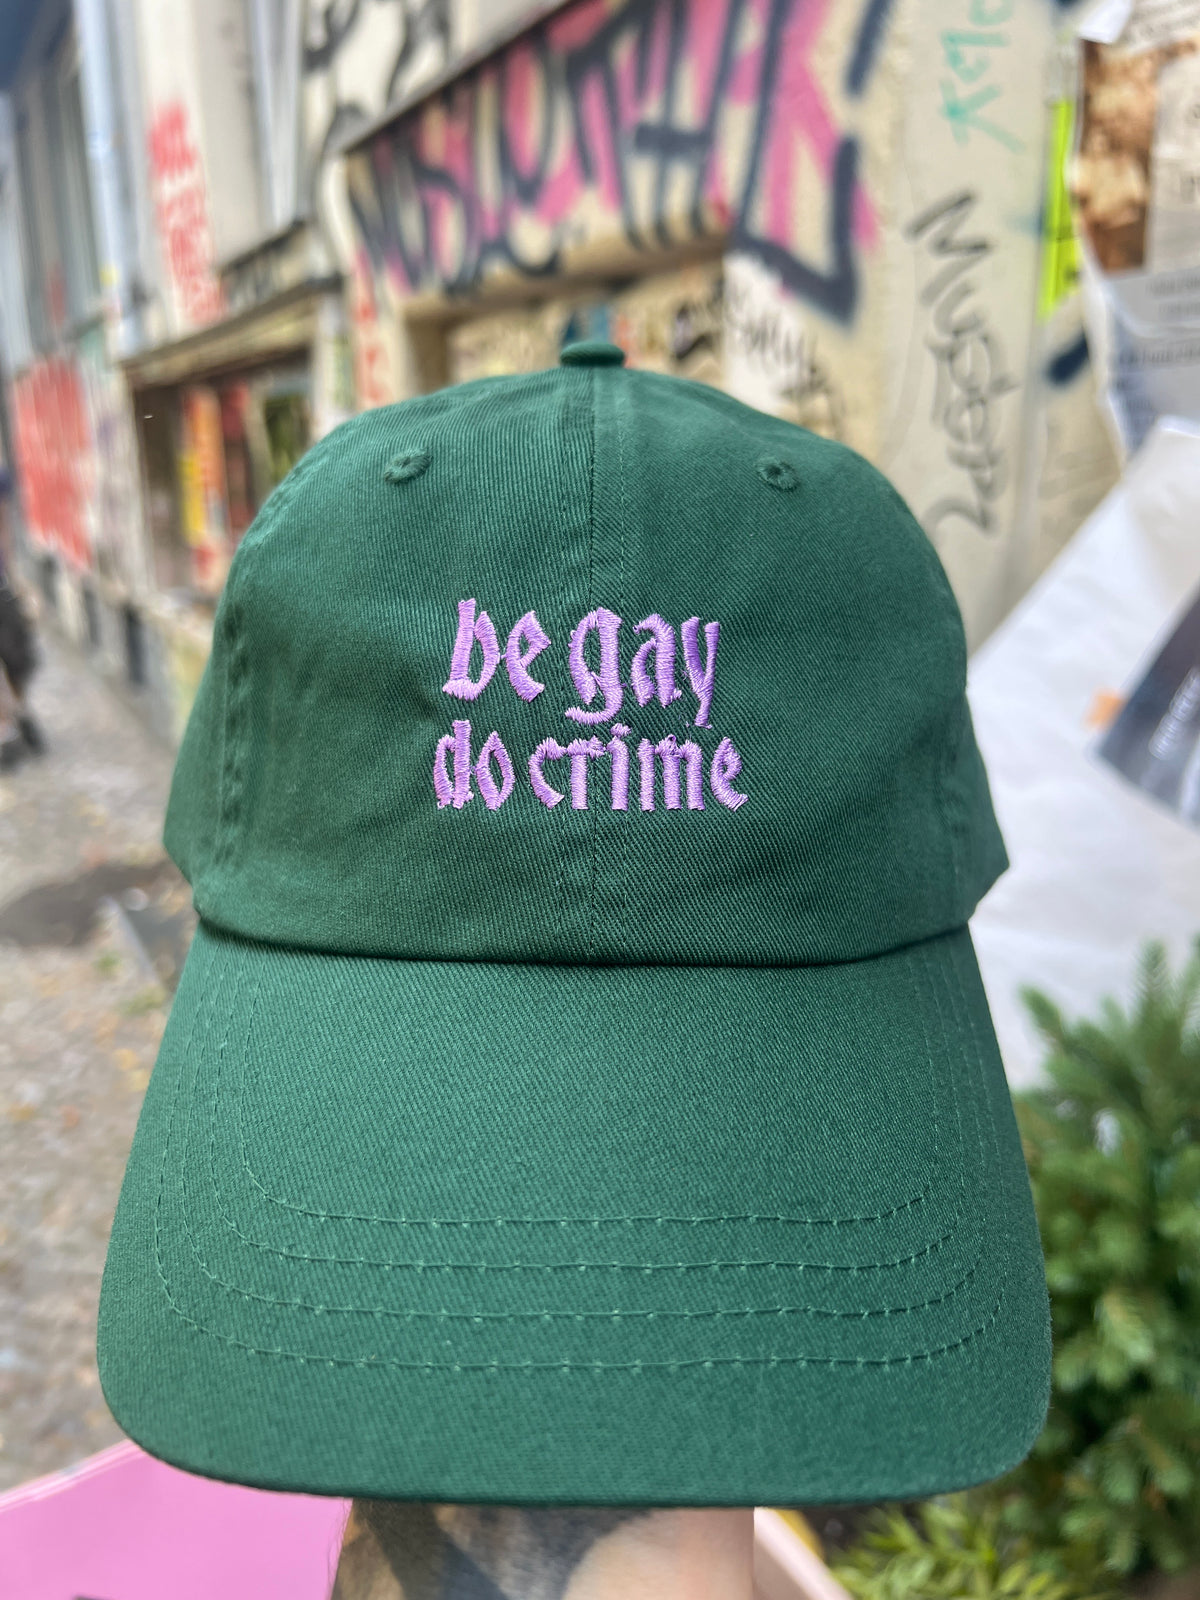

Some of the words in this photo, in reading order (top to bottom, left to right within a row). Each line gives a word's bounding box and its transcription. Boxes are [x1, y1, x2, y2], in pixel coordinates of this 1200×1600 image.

[442, 598, 551, 702] be
[564, 606, 720, 729] gay
[433, 719, 515, 811] do
[528, 722, 749, 811] crime
